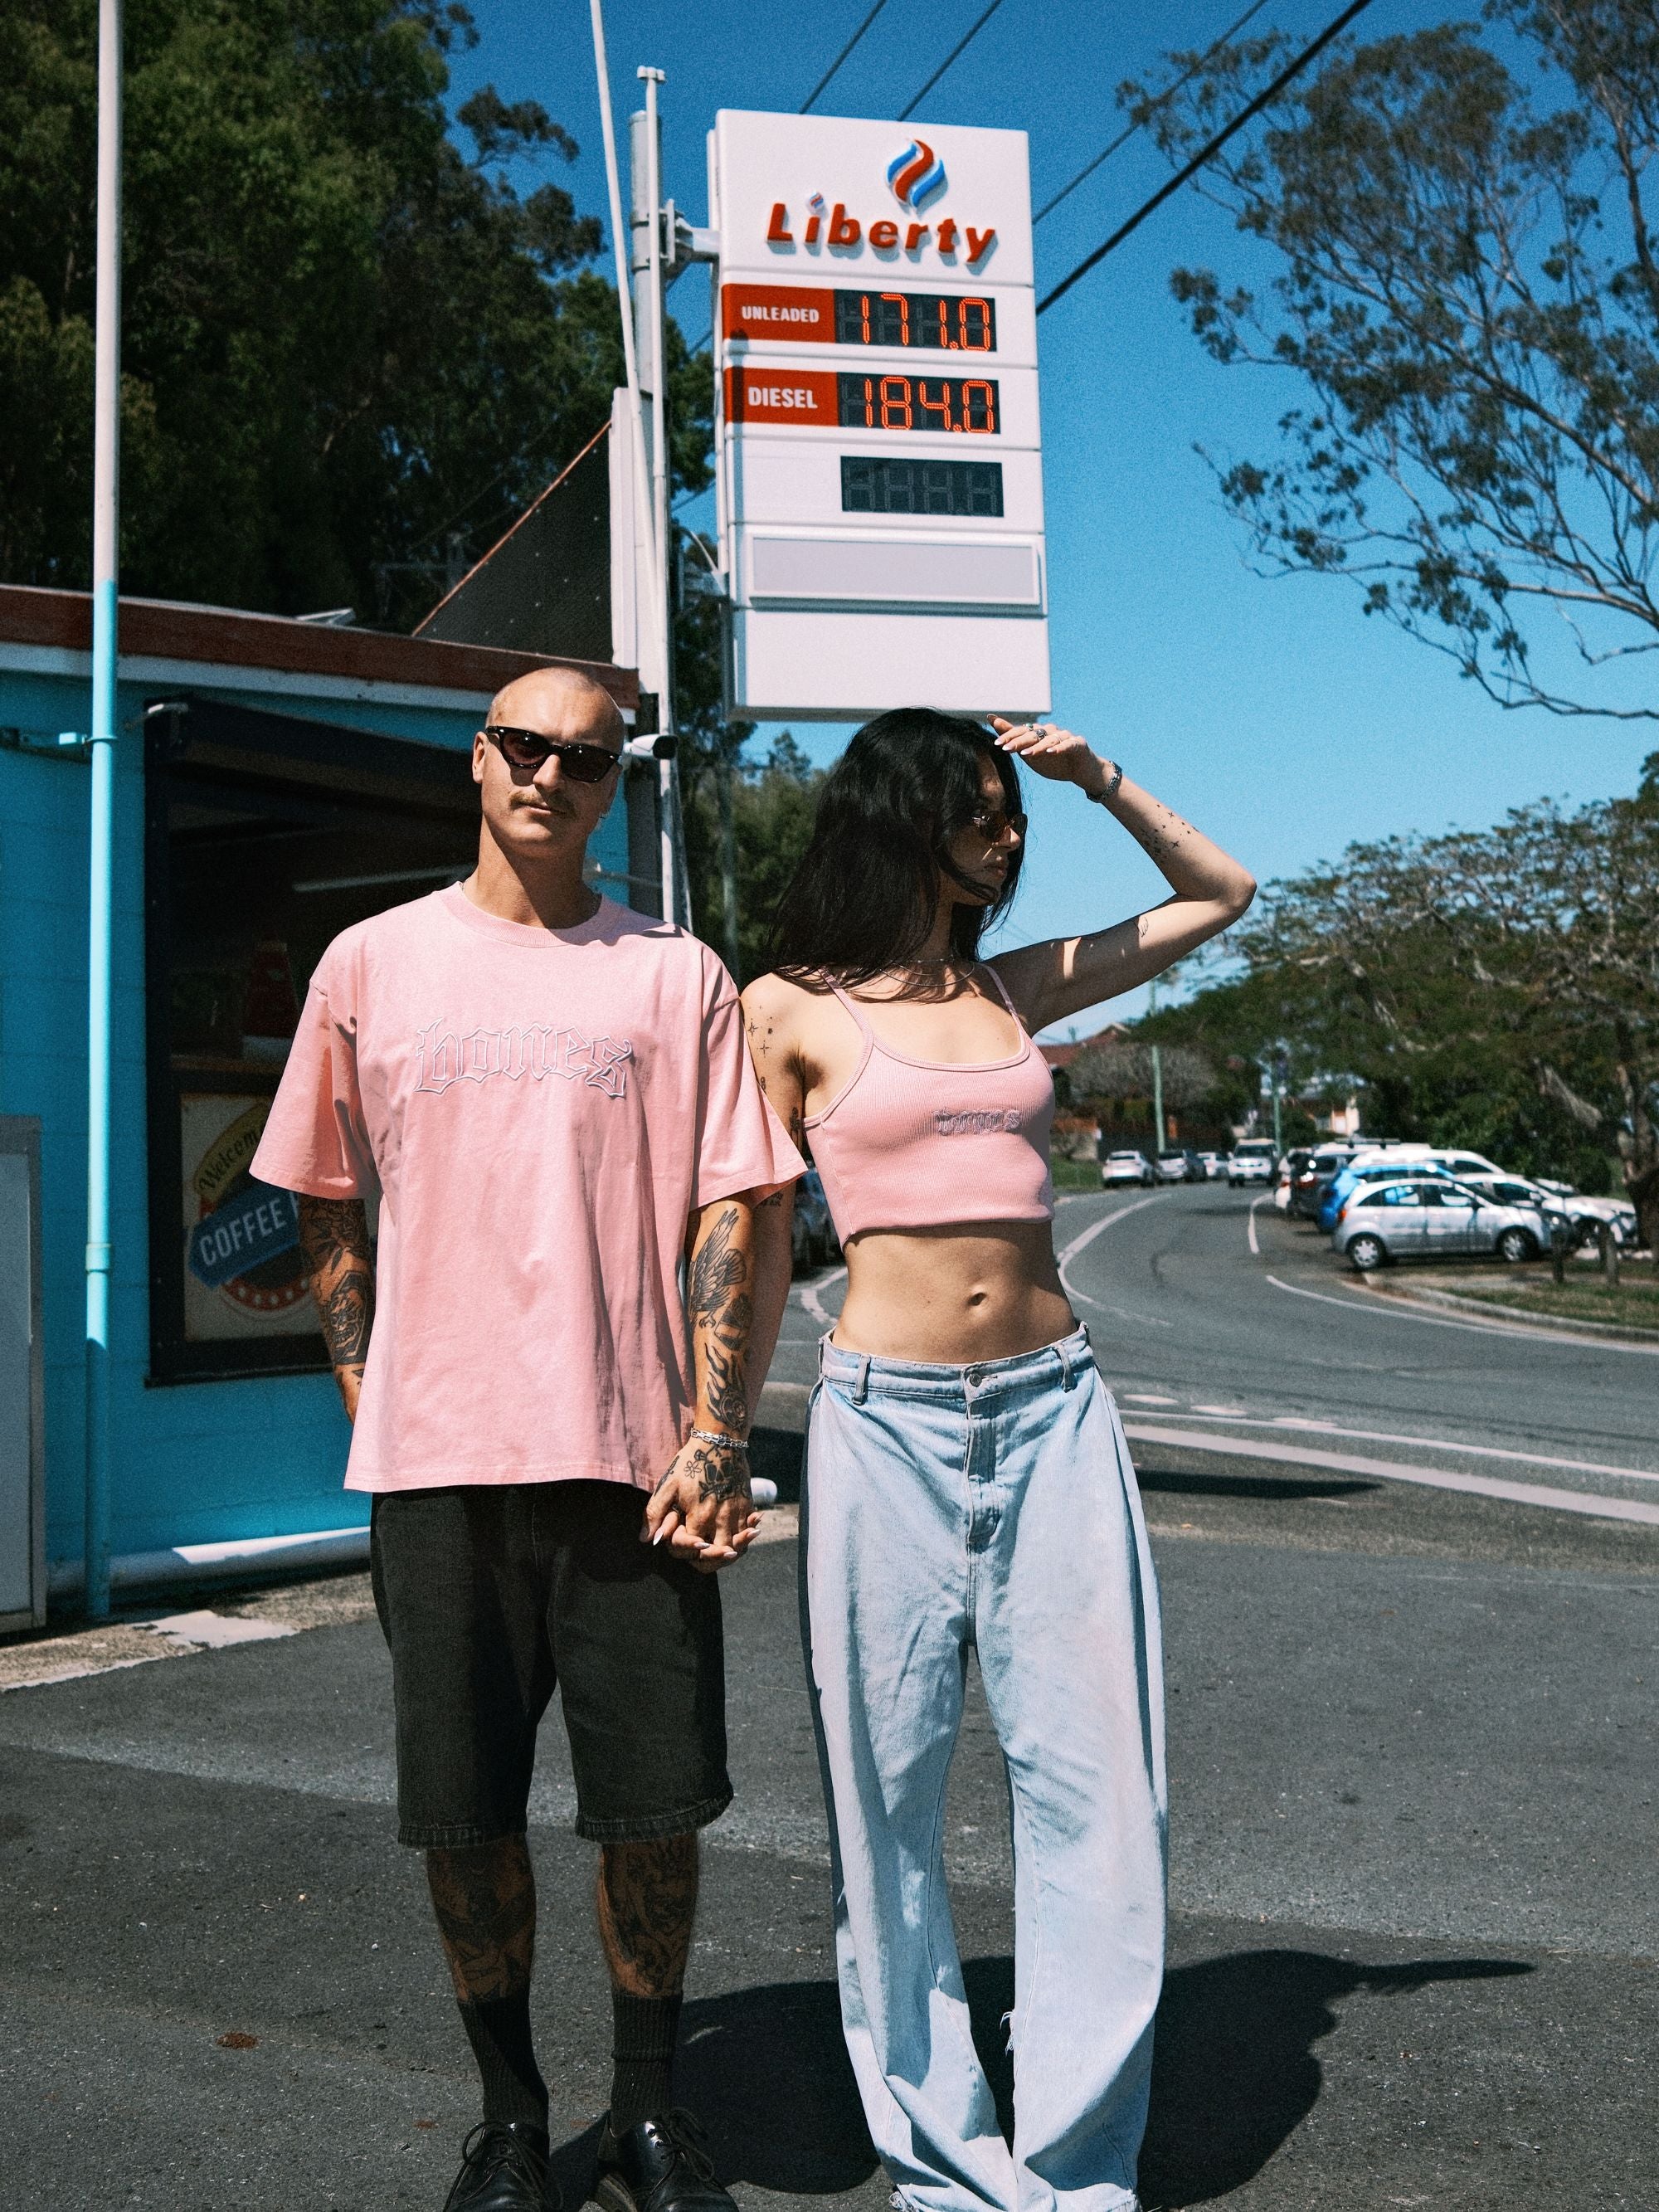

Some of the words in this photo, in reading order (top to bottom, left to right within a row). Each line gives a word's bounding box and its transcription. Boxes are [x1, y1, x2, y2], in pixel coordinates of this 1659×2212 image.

[766, 194, 995, 263] Liberty
[742, 305, 820, 323] UNLEADED
[861, 292, 991, 351] 171.0
[748, 387, 818, 409] DIESEL
[865, 376, 994, 433] 184.0
[198, 1127, 263, 1190] Welcom
[200, 1200, 286, 1266] COFFEE
